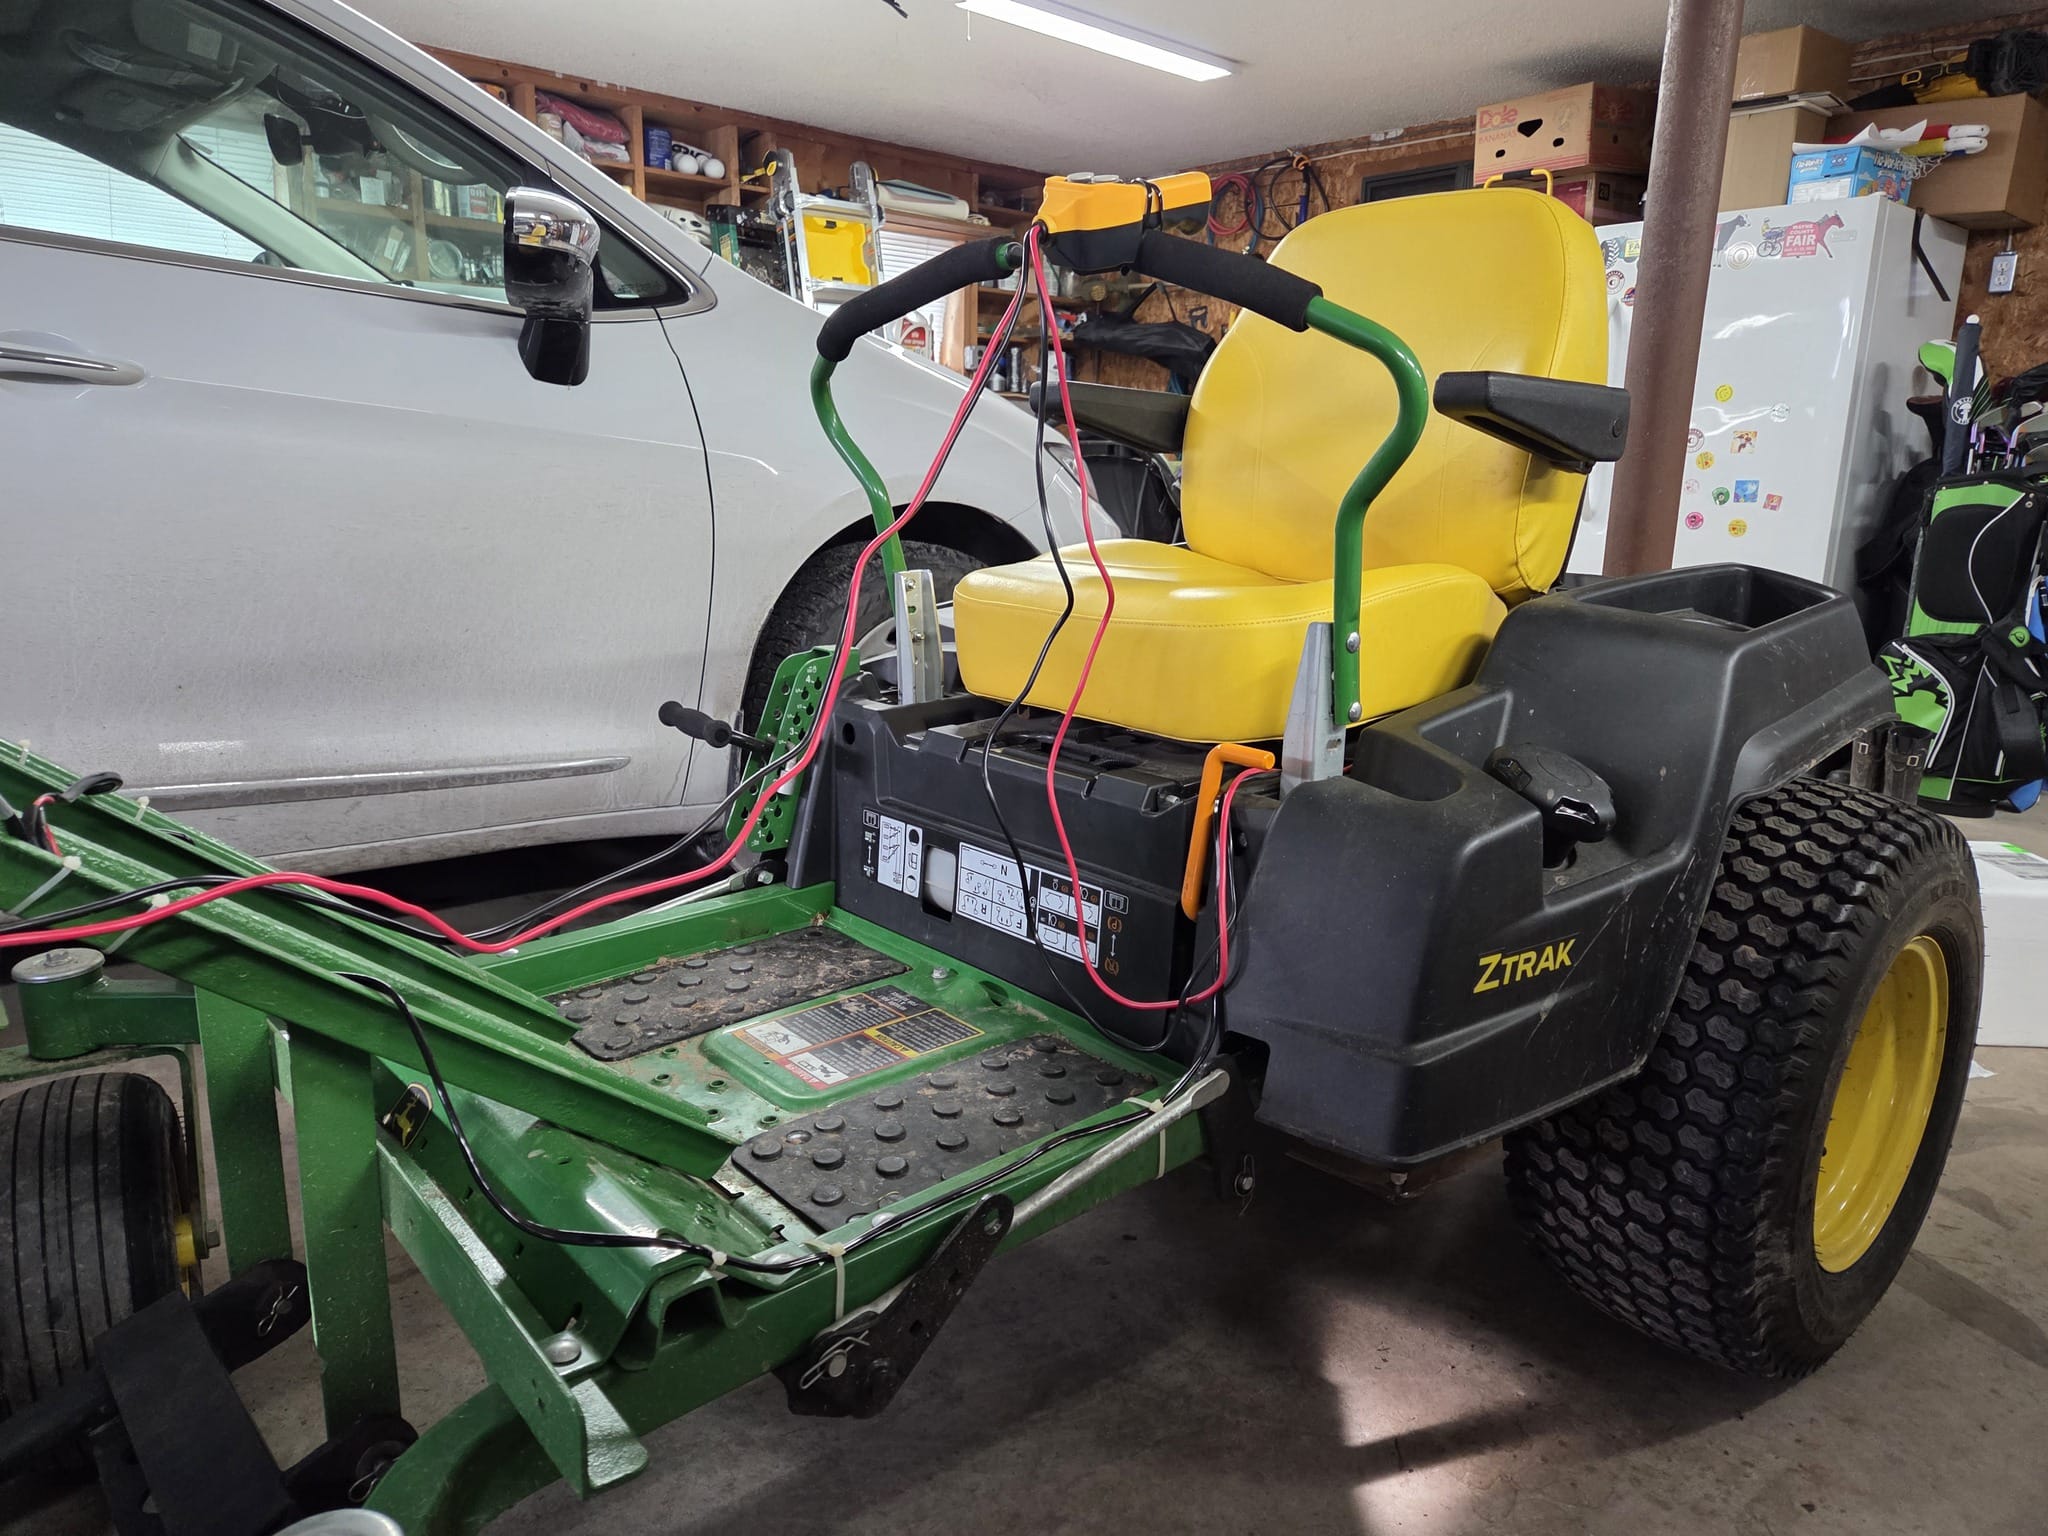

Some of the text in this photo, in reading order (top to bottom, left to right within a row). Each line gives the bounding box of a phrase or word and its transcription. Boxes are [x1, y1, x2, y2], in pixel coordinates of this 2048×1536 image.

[1479, 105, 1519, 129] Dole
[1785, 234, 1816, 247] FAIR
[789, 727, 795, 736] 3
[1000, 864, 1008, 877] N
[980, 904, 987, 915] R
[1016, 918, 1023, 930] F
[1473, 938, 1576, 994] ZTRAK
